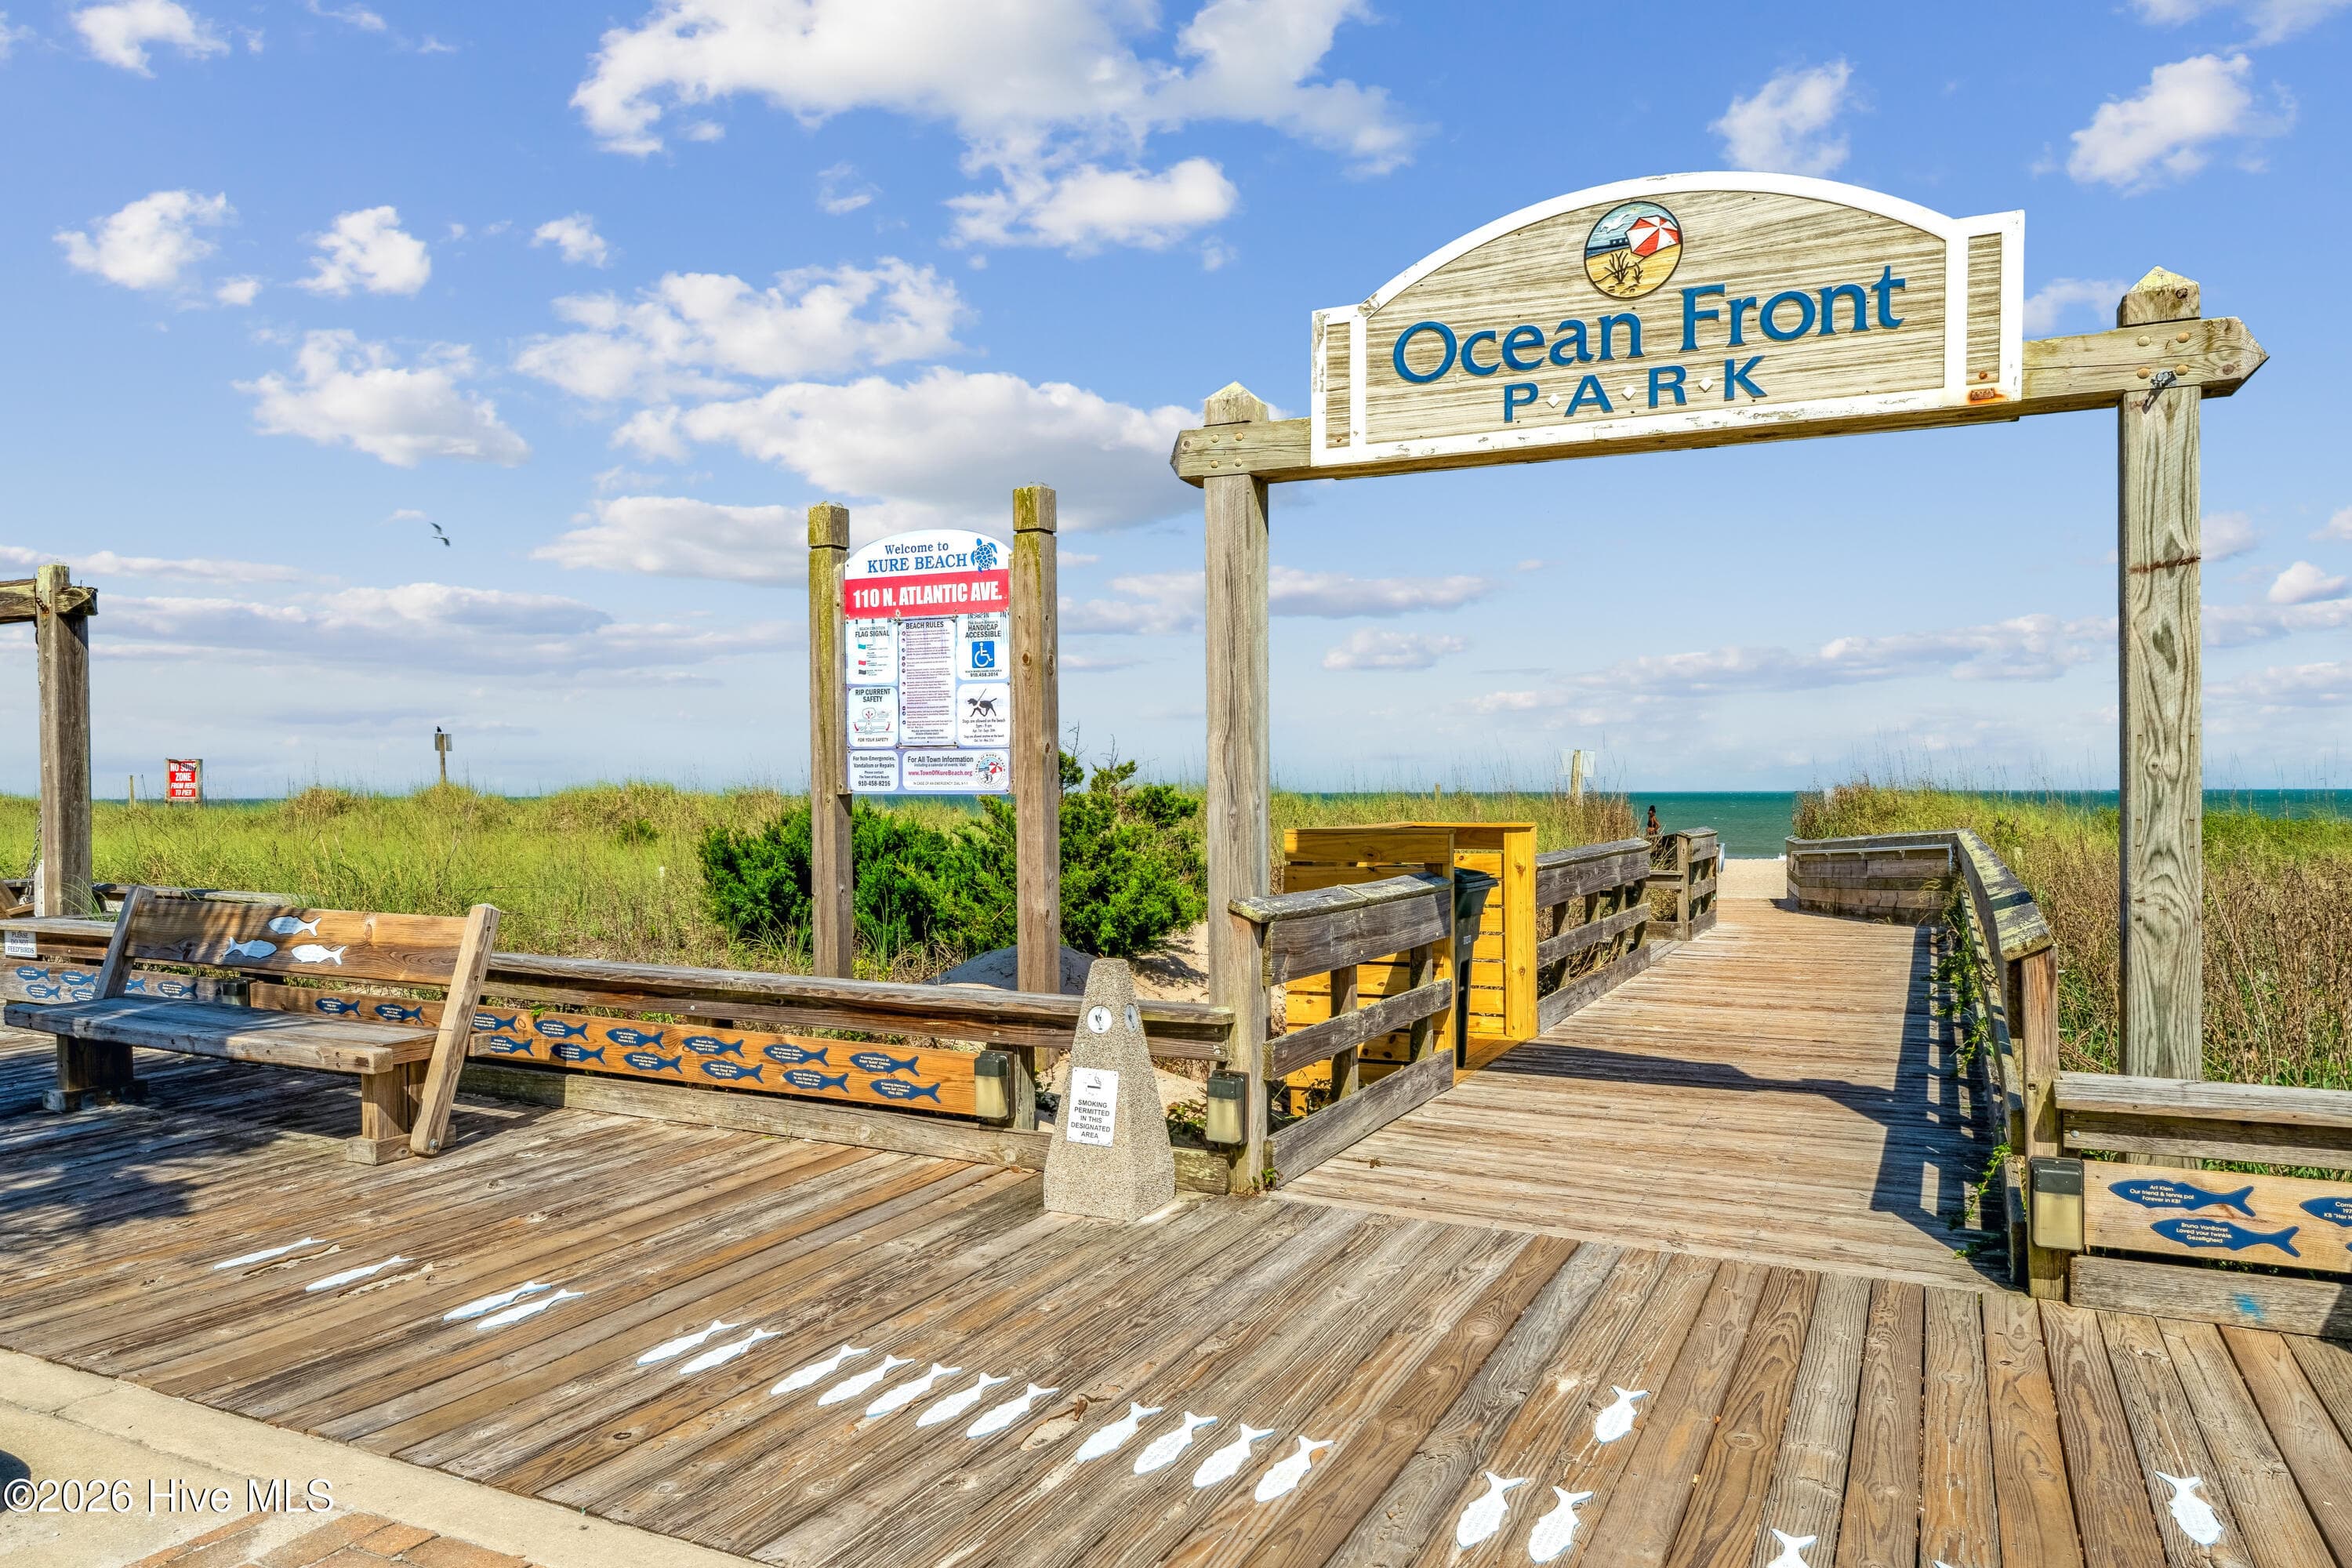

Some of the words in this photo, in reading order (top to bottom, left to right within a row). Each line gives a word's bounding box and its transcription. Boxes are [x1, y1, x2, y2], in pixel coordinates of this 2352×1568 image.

[1392, 311, 1646, 383] Ocean
[1680, 266, 1906, 352] Front
[885, 543, 934, 554] Welcome
[938, 542, 949, 551] to
[867, 557, 909, 573] KURE
[914, 554, 967, 570] BEACH
[853, 589, 880, 608] 110
[883, 587, 896, 606] N.
[899, 583, 967, 606] ATLANTIC
[970, 581, 1003, 602] AVE.
[170, 763, 180, 772] NO
[175, 772, 192, 782] ZONE
[1078, 1099, 1108, 1109] SMOKING
[1074, 1107, 1110, 1116] PERMITTED
[1071, 1122, 1111, 1133] DESIGNATED
